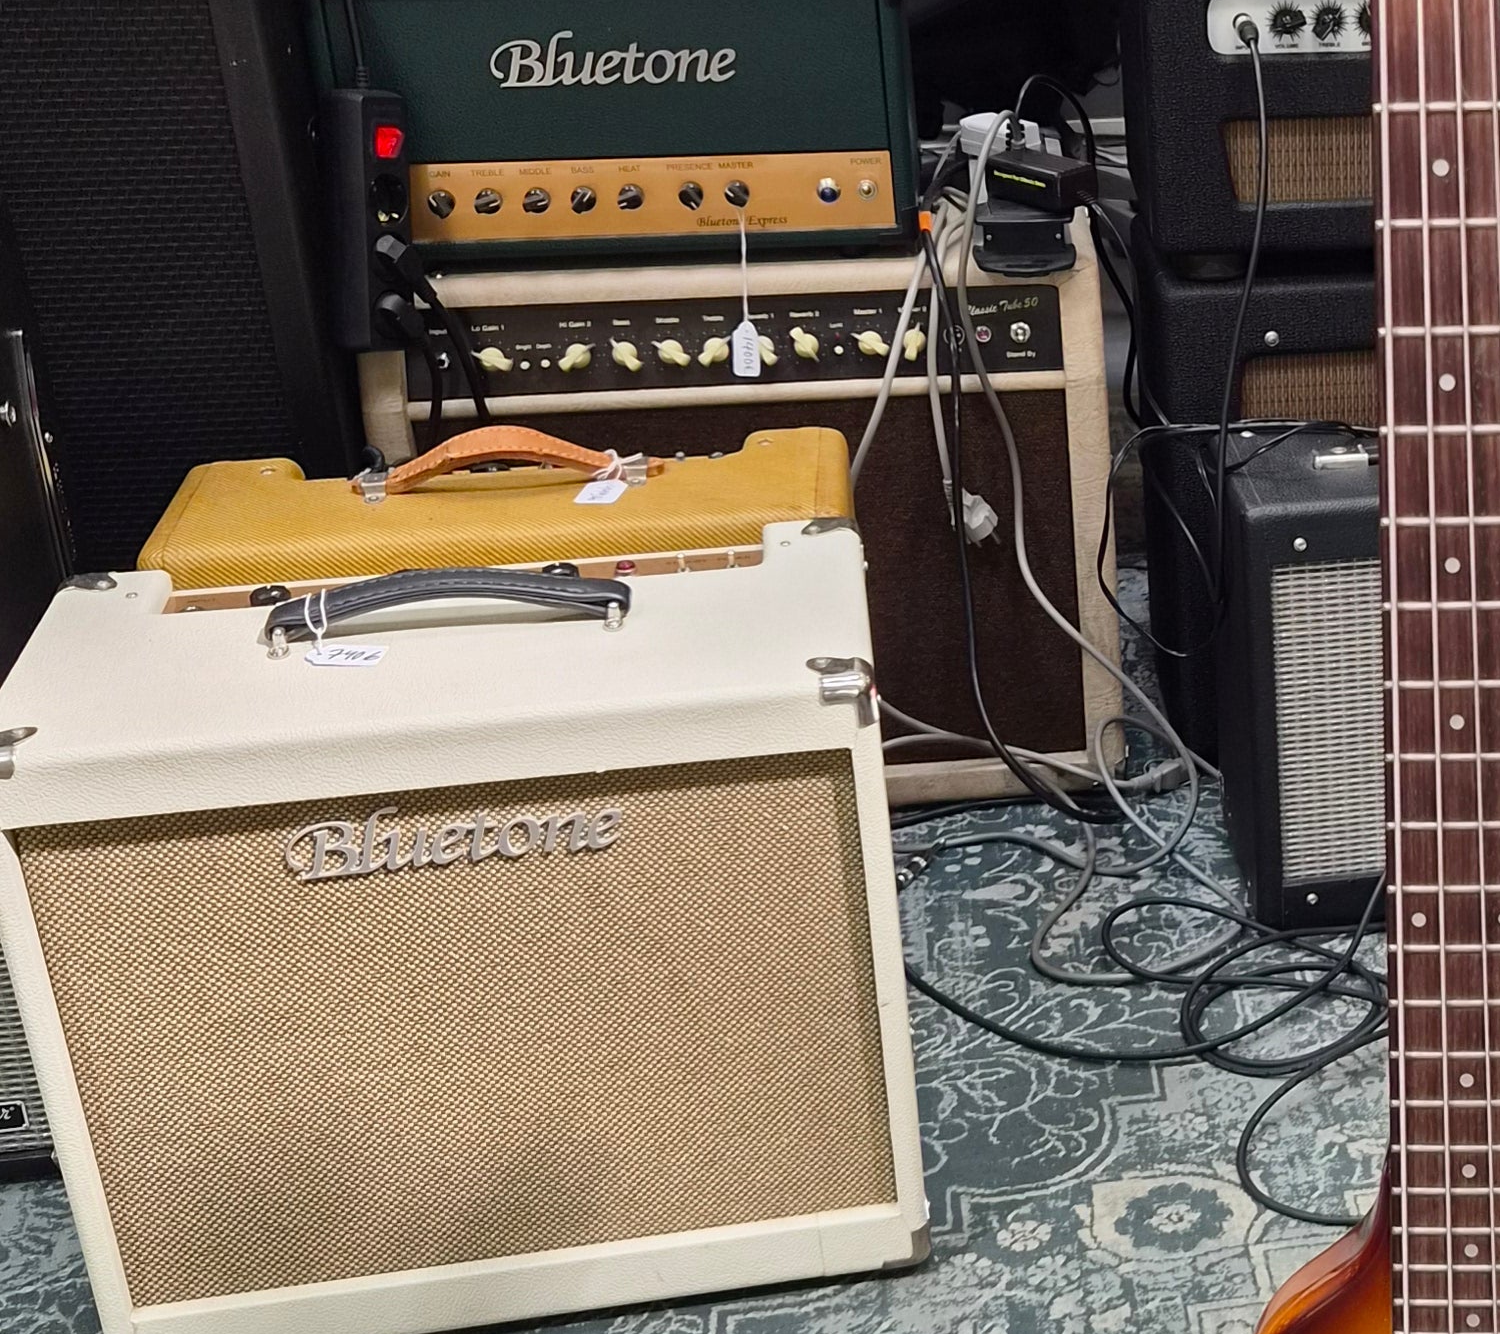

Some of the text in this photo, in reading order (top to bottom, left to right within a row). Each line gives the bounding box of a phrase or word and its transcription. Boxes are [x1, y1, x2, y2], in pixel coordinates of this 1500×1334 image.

[489, 30, 736, 88] Bluetone
[718, 161, 754, 169] MASTER
[471, 169, 505, 178] TREBLE
[519, 167, 551, 176] MIDDLE
[570, 166, 595, 174] BASS
[697, 216, 743, 228] Blueton
[285, 806, 622, 881] Bluetone
